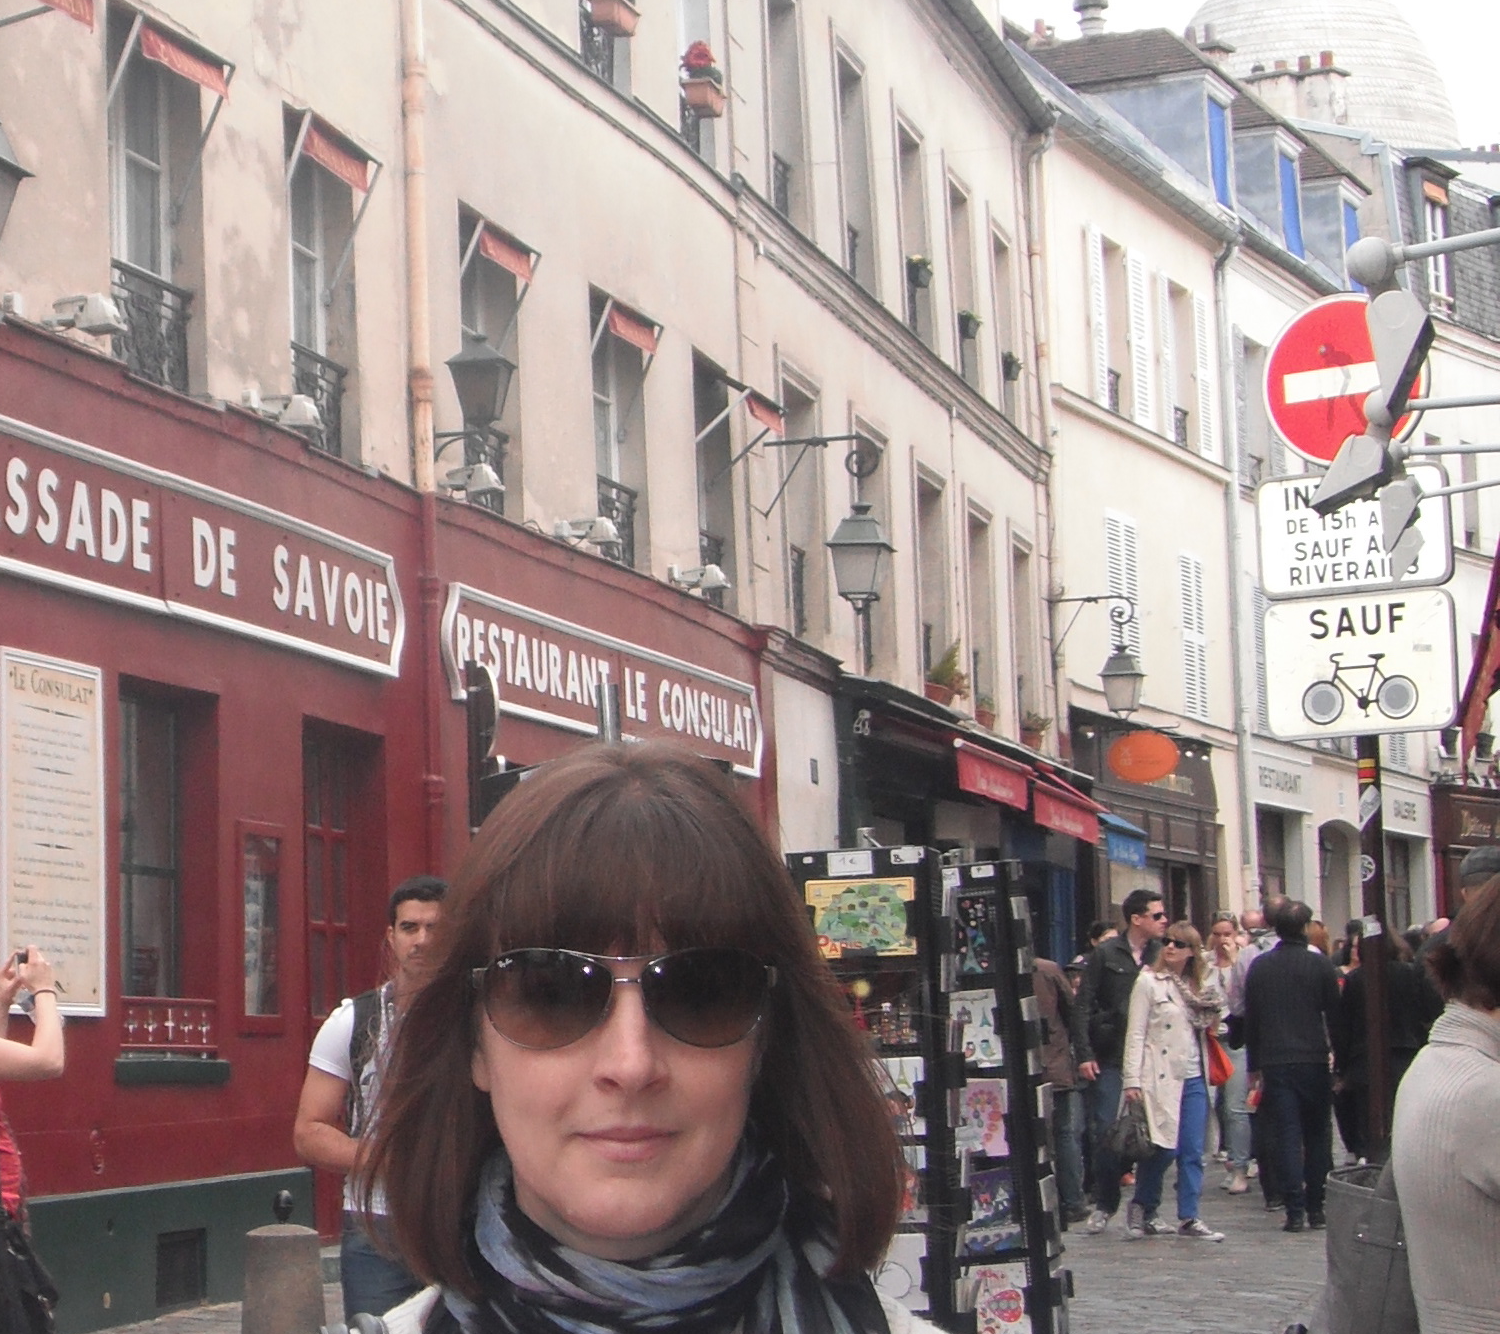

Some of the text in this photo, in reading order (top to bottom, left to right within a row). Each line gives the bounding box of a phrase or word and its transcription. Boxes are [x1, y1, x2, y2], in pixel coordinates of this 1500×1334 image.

[1286, 517, 1310, 535] DE
[1294, 537, 1354, 562] SAUF
[191, 517, 238, 596] DE
[273, 543, 391, 645] SAVOIE
[1289, 557, 1420, 586] RIVERAIS
[1309, 601, 1407, 640] SAUF
[13, 666, 26, 691] LE
[457, 612, 753, 752] RESTAURANT LE CONSULAT
